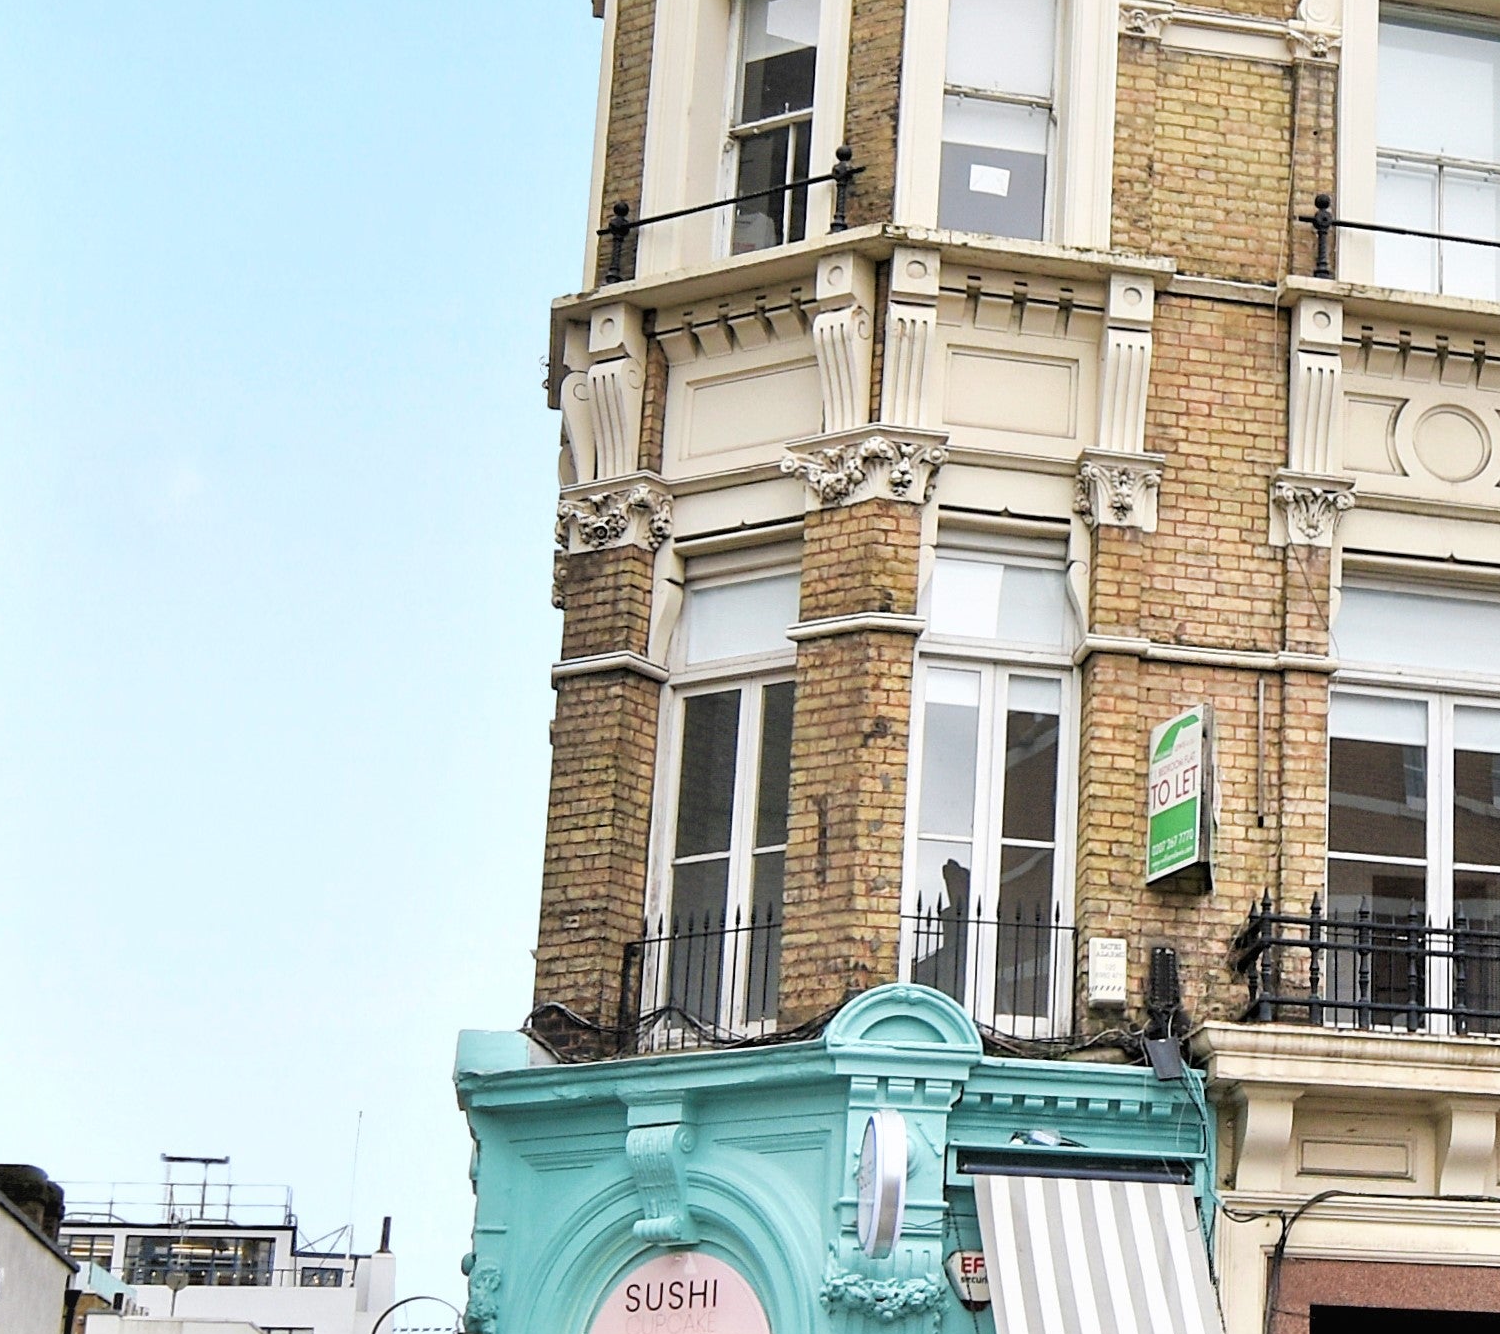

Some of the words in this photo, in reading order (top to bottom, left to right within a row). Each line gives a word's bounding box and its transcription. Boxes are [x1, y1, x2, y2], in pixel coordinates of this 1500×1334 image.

[1151, 779, 1171, 810] TO
[1175, 765, 1198, 799] LET
[625, 1278, 718, 1313] SUSHI
